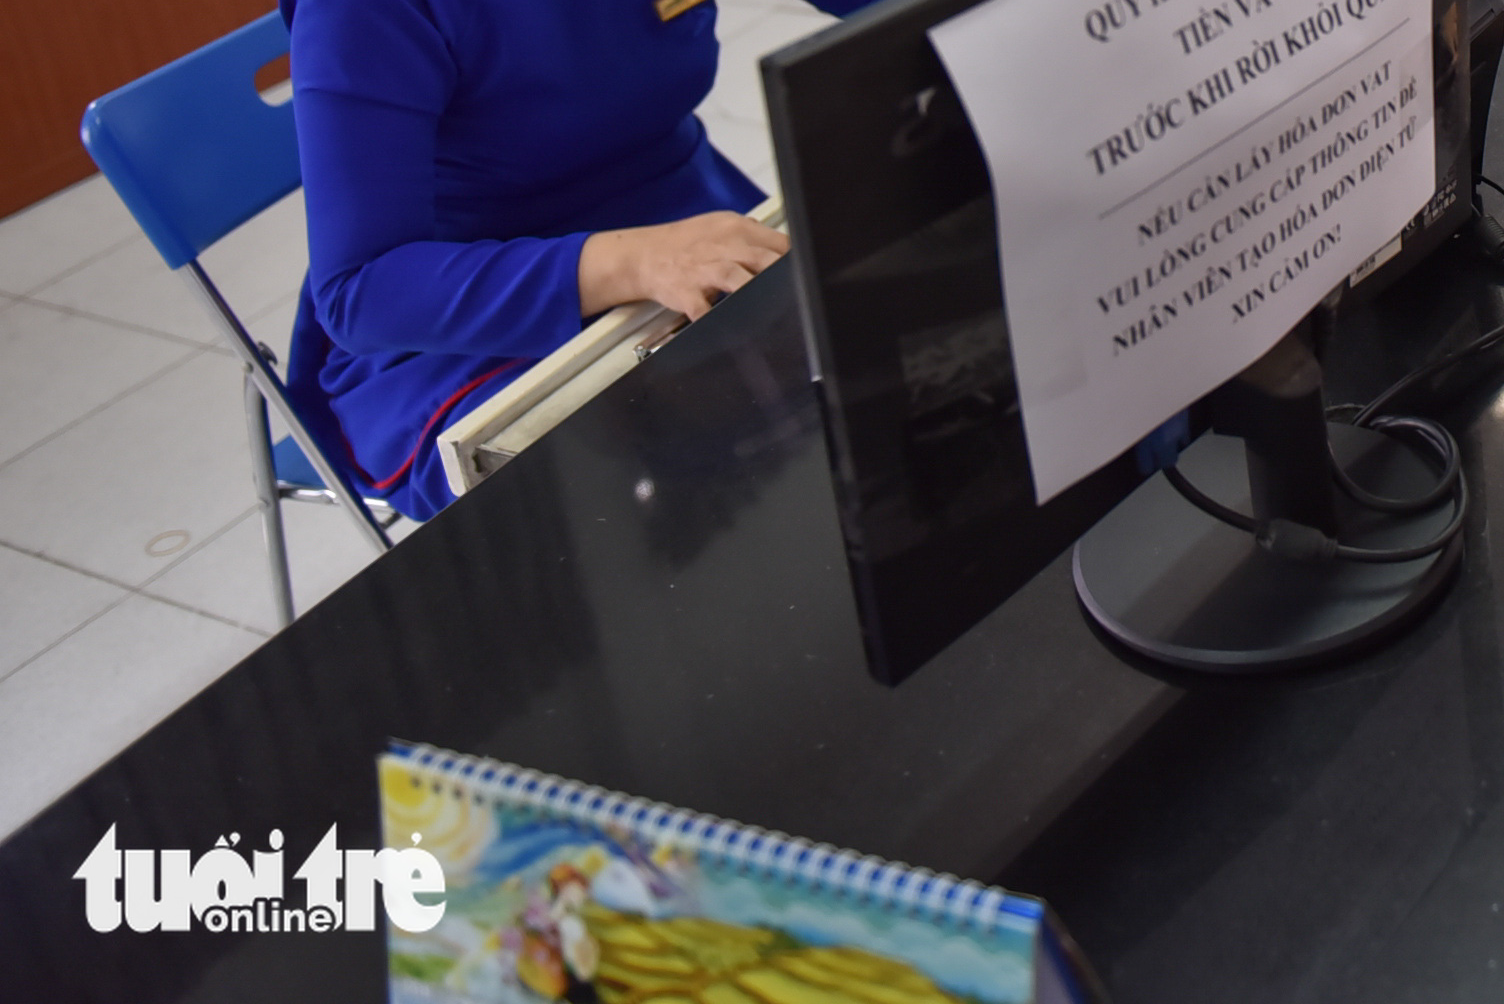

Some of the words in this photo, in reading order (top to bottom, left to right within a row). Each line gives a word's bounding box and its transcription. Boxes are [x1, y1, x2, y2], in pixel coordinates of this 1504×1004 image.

[1085, 97, 1185, 178] TRƯỚC
[1186, 67, 1235, 116] KHI
[1234, 38, 1282, 86] RỜI
[1282, 1, 1343, 57] KHỎI
[1172, 2, 1233, 56] TIỀN
[1097, 276, 1140, 314] VUI
[1145, 232, 1207, 289] LÒNG
[1210, 192, 1266, 244] CUNG
[1269, 165, 1306, 204] CẤP
[1309, 120, 1369, 175] THÔNG
[1372, 98, 1398, 130] TIN
[1138, 201, 1183, 245] NẾU
[1235, 142, 1274, 183] LẤY
[1278, 116, 1318, 155] HÓA
[1360, 60, 1392, 95] VAT
[1113, 299, 1178, 357] NHÂN
[1182, 262, 1232, 307] VIÊN
[1237, 231, 1276, 272] TẠO
[1279, 203, 1318, 243] HÓA
[1232, 282, 1265, 324] XIN
